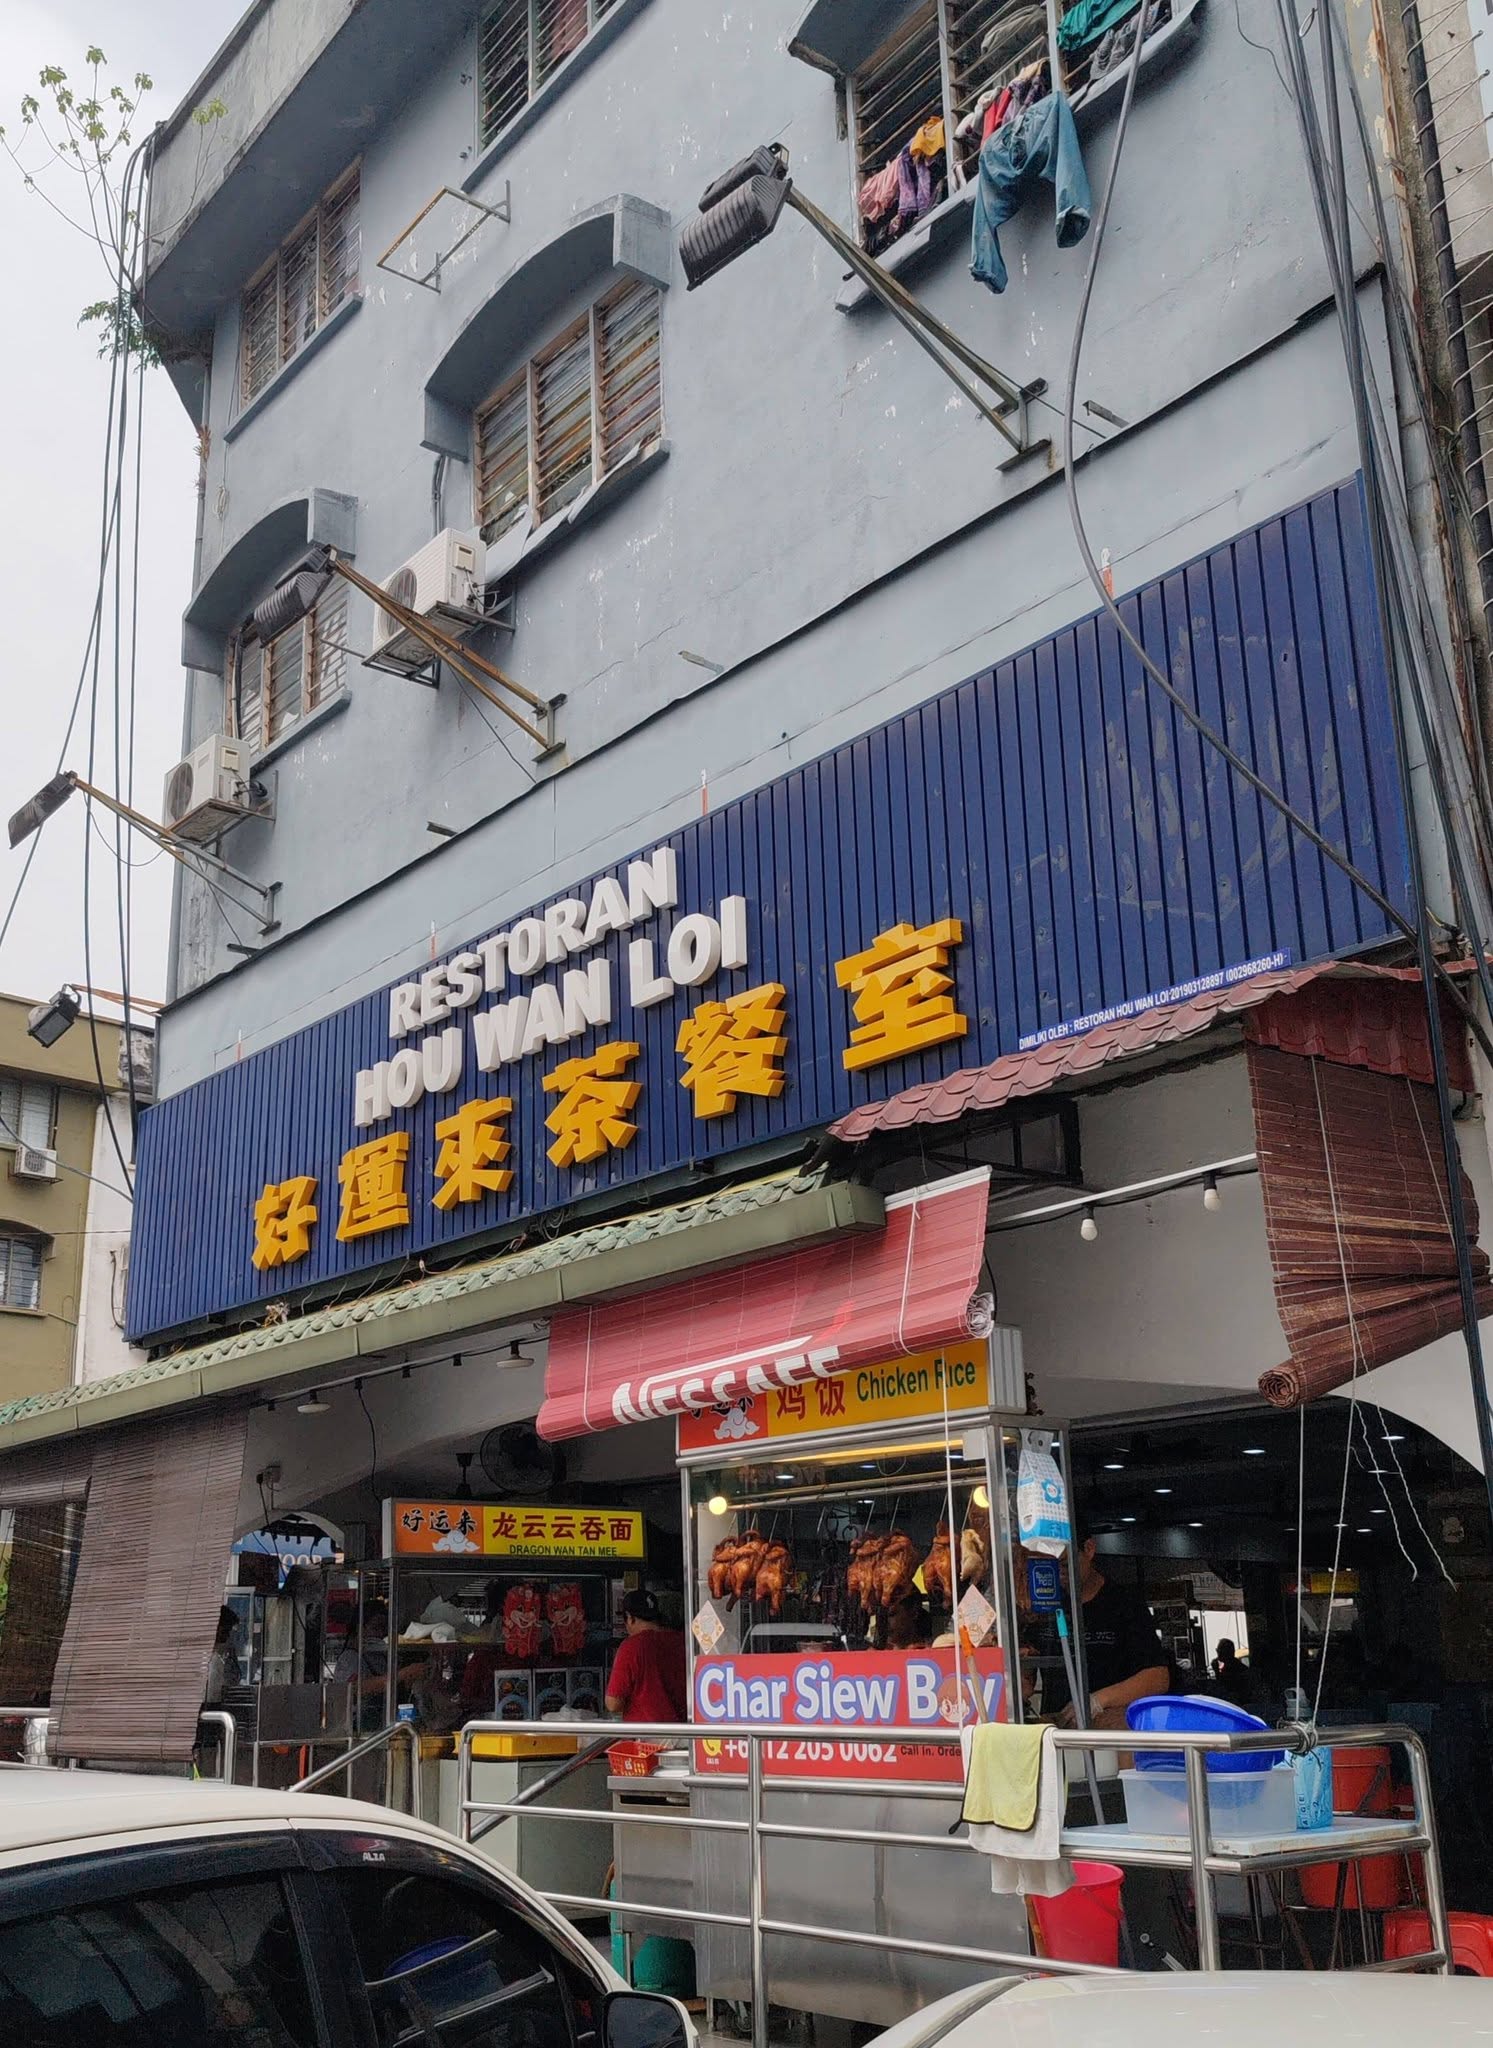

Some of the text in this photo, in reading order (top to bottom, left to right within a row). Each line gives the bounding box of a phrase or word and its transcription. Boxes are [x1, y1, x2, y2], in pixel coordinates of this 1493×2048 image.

[389, 846, 678, 1039] RESTORAN
[354, 894, 748, 1128] HOU WAN LOI
[1019, 1030, 1047, 1050] DIMILIKI
[1048, 1023, 1068, 1039] OLEH
[1073, 1007, 1115, 1032] RESTORAN
[1116, 1002, 1134, 1018] HOU
[1134, 994, 1154, 1011] WAN
[251, 917, 968, 1271] 好運來茶餐室
[857, 1359, 976, 1402] Chicken Rice
[402, 1508, 477, 1535] 好运来
[492, 1511, 634, 1541] 龙云云吞面
[509, 1545, 617, 1556] DRAGON WAN TAN MEE
[700, 1665, 787, 1719] Char
[795, 1665, 896, 1719] Siew
[901, 1745, 919, 1756] Call
[938, 1746, 961, 1757] Orde
